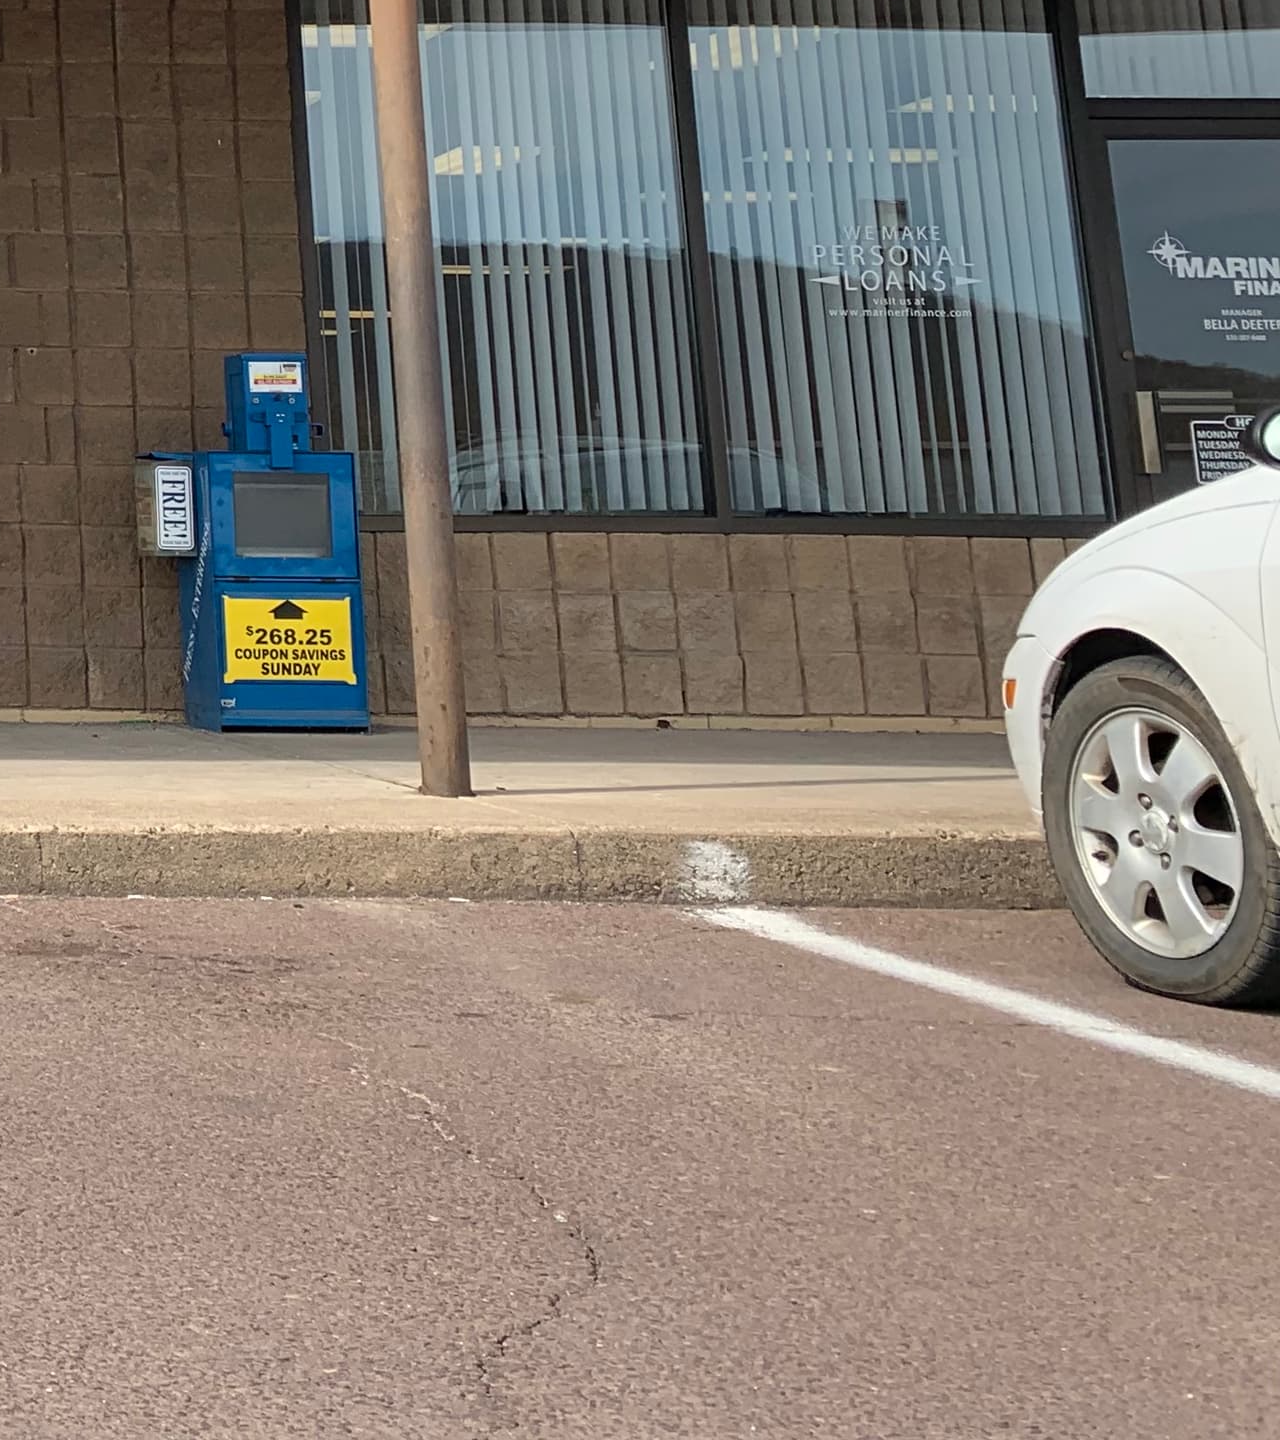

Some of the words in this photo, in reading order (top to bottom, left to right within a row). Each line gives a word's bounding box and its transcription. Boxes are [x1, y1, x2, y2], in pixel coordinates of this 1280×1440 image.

[844, 225, 874, 241] WE
[882, 225, 941, 241] MAKE
[813, 244, 975, 266] PERSONAL
[844, 270, 947, 292] LOANS
[873, 296, 896, 305] visit
[915, 297, 925, 305] at
[1204, 319, 1239, 330] BELLA
[1196, 431, 1239, 439] MONDAY
[1198, 441, 1240, 449] TUESDAY
[1199, 451, 1248, 459] WEDNESD
[1200, 461, 1249, 470] THURSDAY
[161, 479, 188, 539] FREE!
[246, 626, 332, 645] $268.25
[235, 648, 288, 660] COUPON
[292, 649, 346, 660] SAVINGS
[261, 662, 321, 676] SUNDAY
